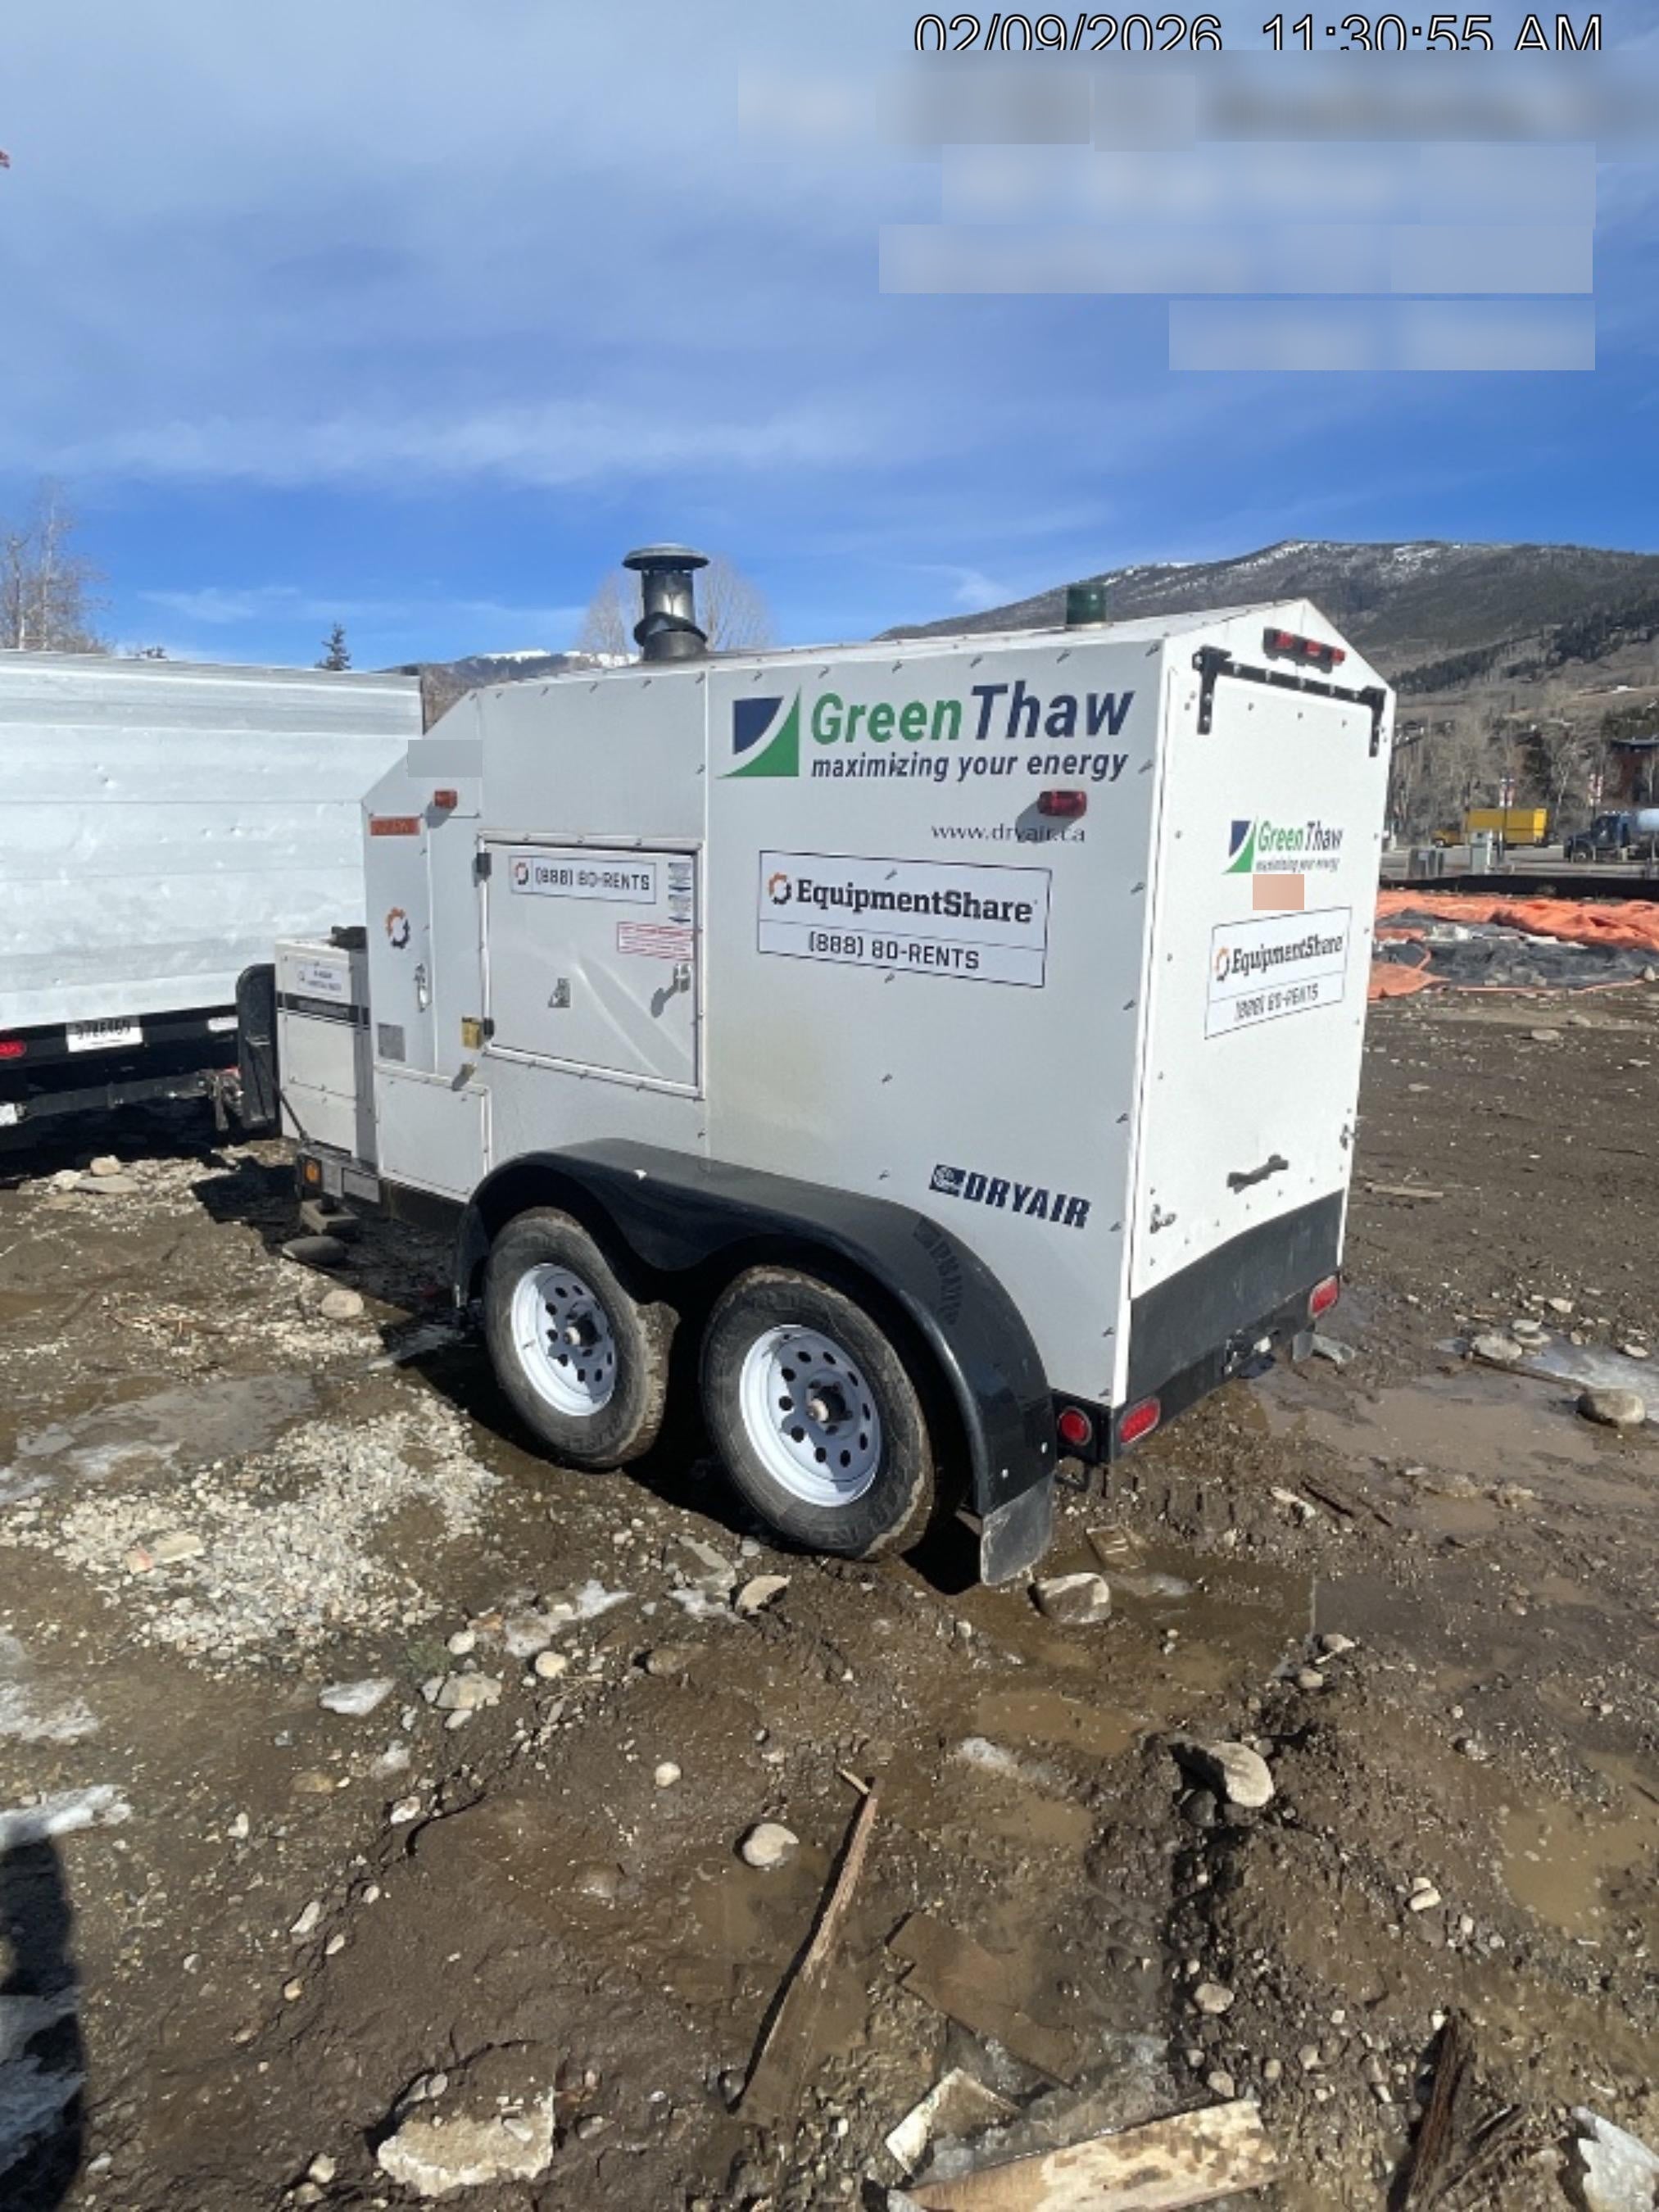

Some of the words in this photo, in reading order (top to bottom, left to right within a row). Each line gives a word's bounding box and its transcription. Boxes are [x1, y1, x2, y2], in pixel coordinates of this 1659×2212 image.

[811, 751, 949, 782] maximizing
[958, 753, 1018, 782] your
[1027, 751, 1129, 782] energy
[931, 823, 1086, 844] www.dryair.ca
[796, 879, 1033, 923] EquipmentShare
[809, 931, 863, 958] (888)
[872, 940, 979, 969] 80-RENTS
[1231, 933, 1343, 977] EquipmentShare
[963, 1171, 1091, 1229] DRYAIR
